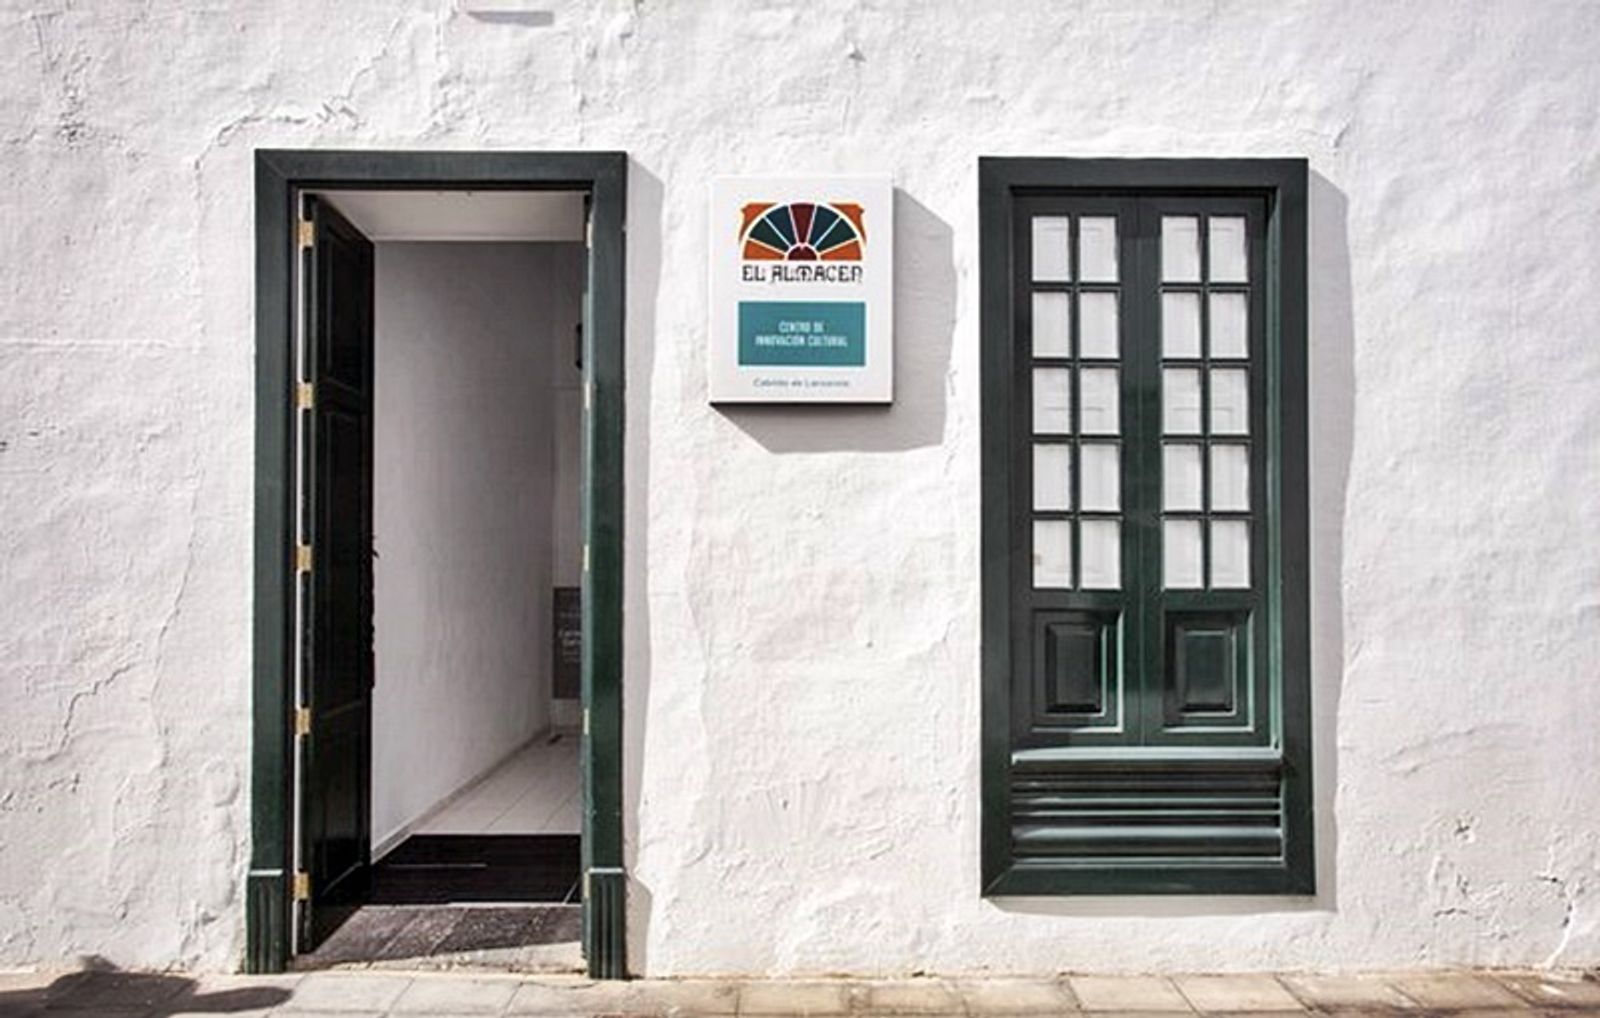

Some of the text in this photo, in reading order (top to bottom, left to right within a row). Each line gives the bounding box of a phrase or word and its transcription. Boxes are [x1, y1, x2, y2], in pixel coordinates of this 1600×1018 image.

[742, 265, 864, 283] EL ALMACEN
[778, 321, 825, 333] CENTRO DE
[808, 336, 848, 348] CULTURAL
